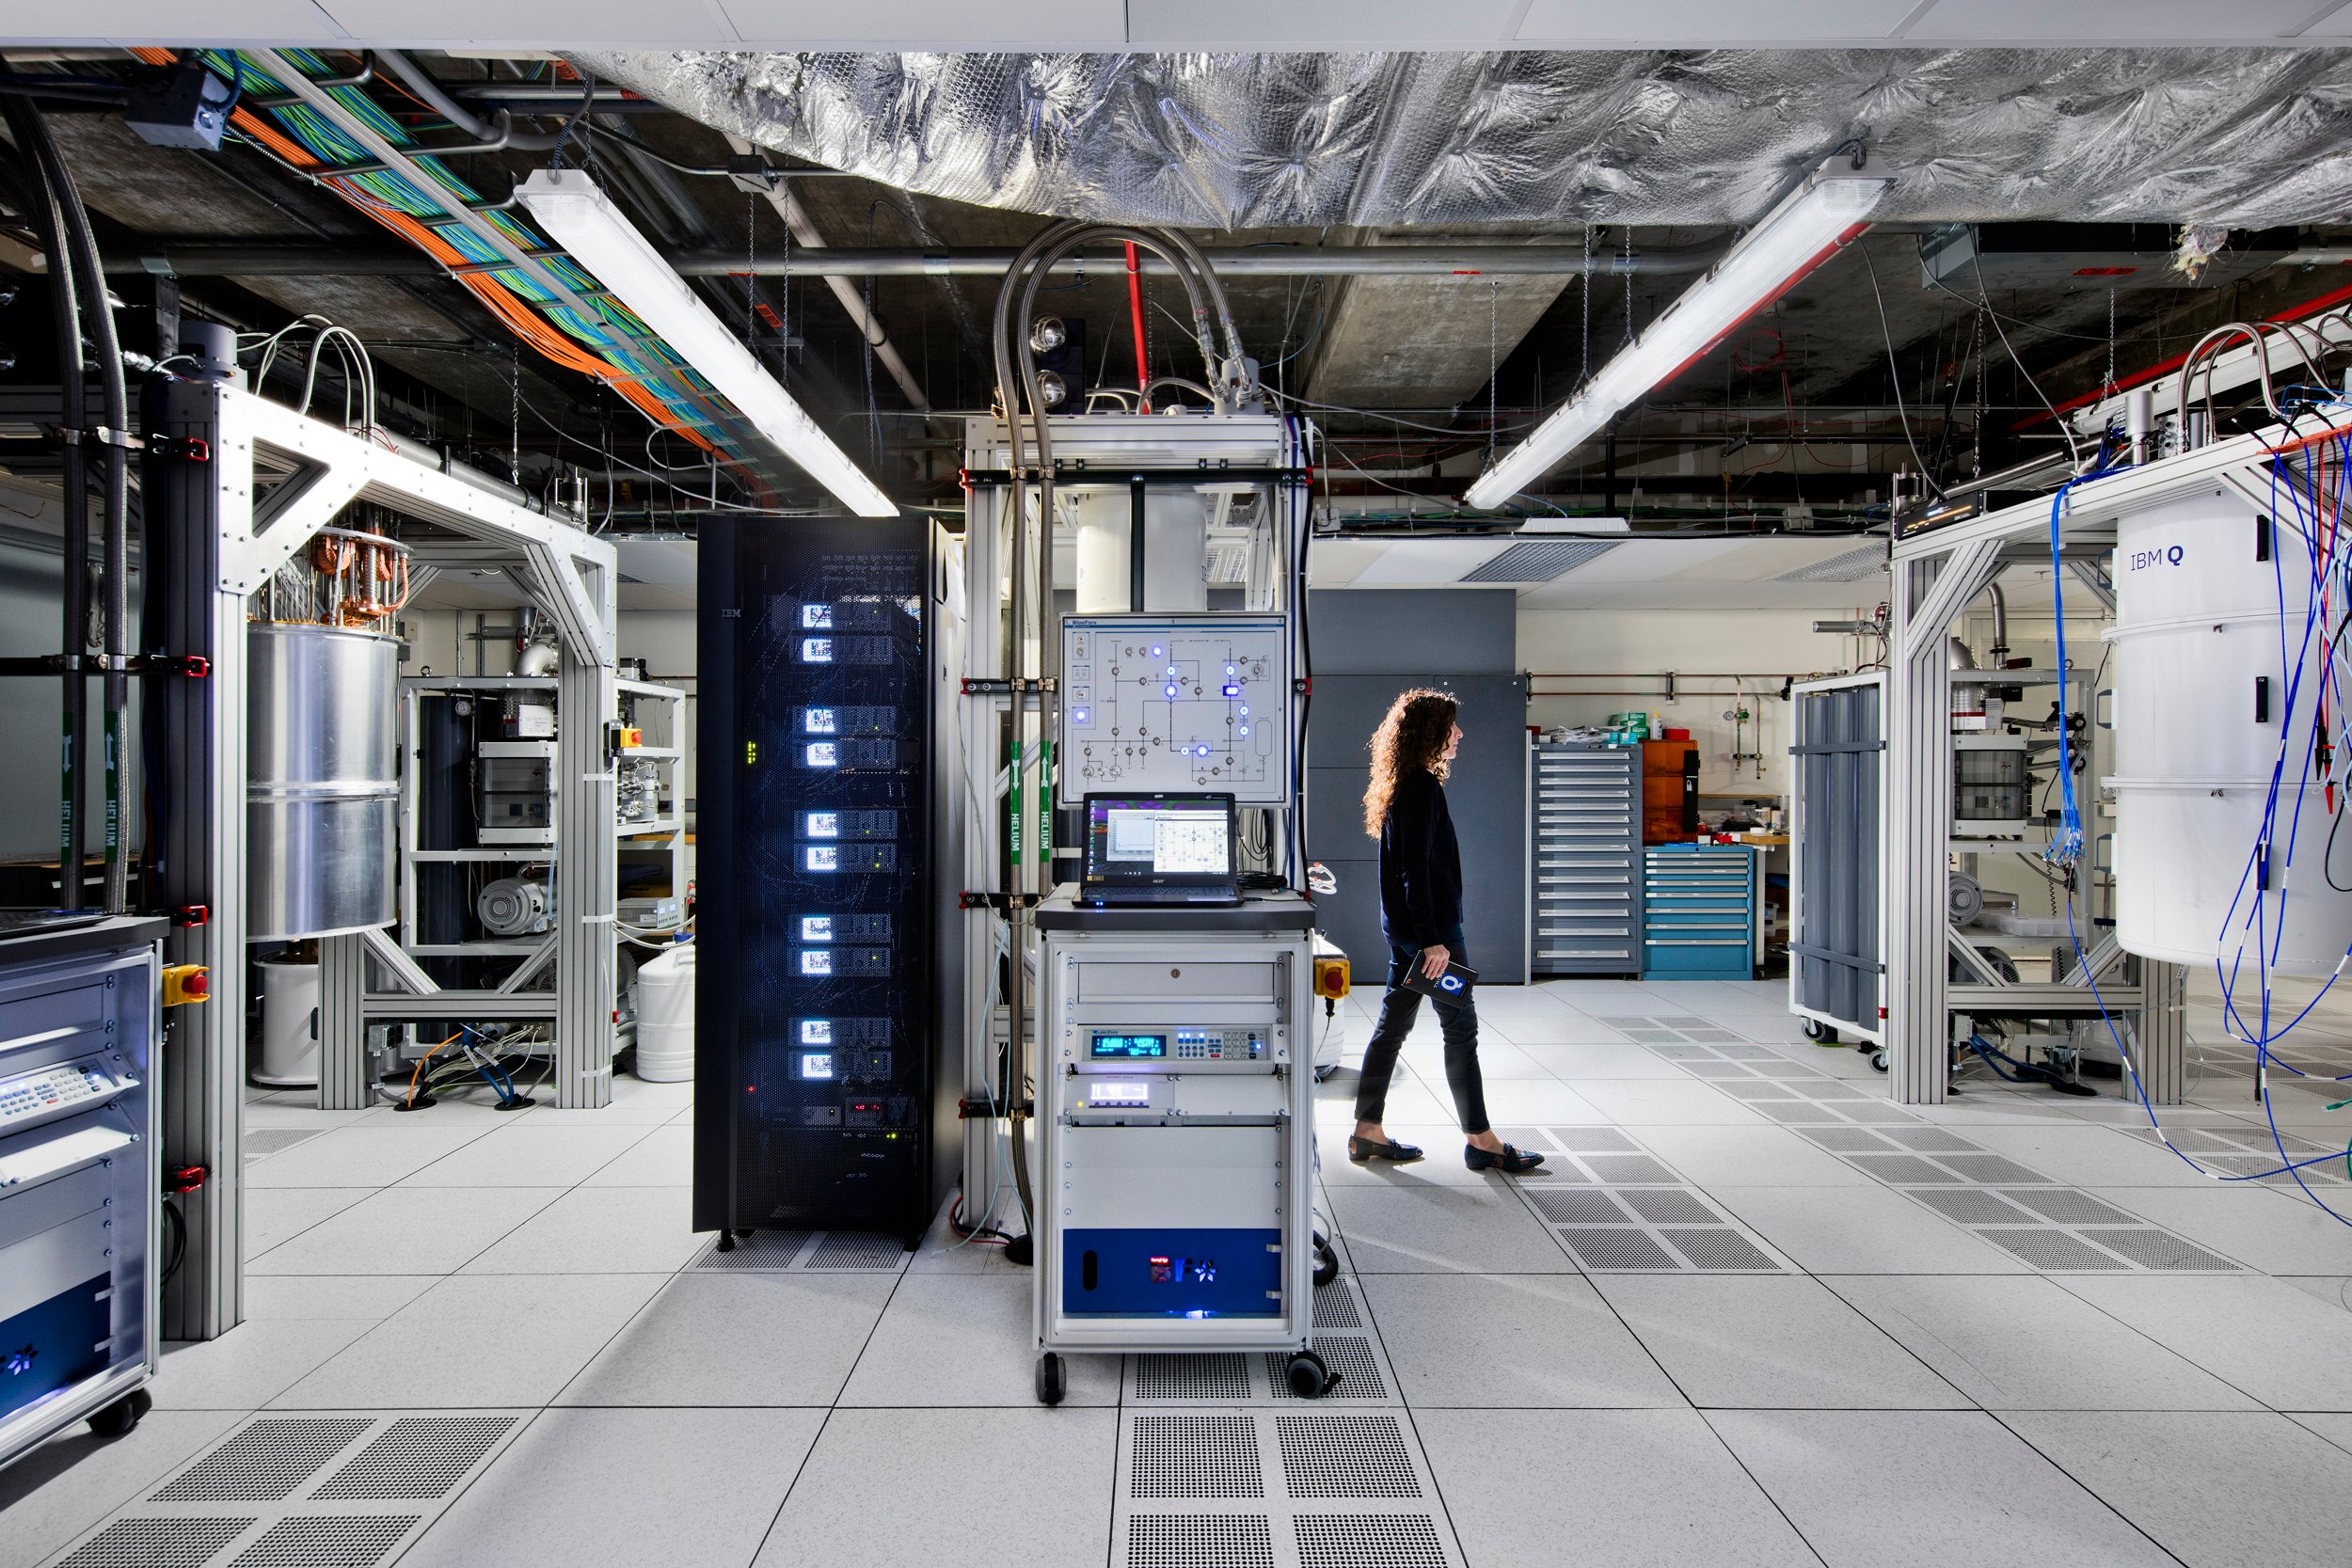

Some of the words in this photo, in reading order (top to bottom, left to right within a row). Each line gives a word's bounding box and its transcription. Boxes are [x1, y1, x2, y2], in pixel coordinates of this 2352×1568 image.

[2131, 548, 2162, 571] IBM
[2168, 546, 2184, 566] Q
[722, 609, 741, 618] IBM
[61, 800, 72, 847] HELIUM
[106, 800, 116, 847] HELIUM
[1011, 813, 1020, 851] HELIUM
[1041, 811, 1049, 849] HELIUM
[1441, 975, 1463, 990] Q
